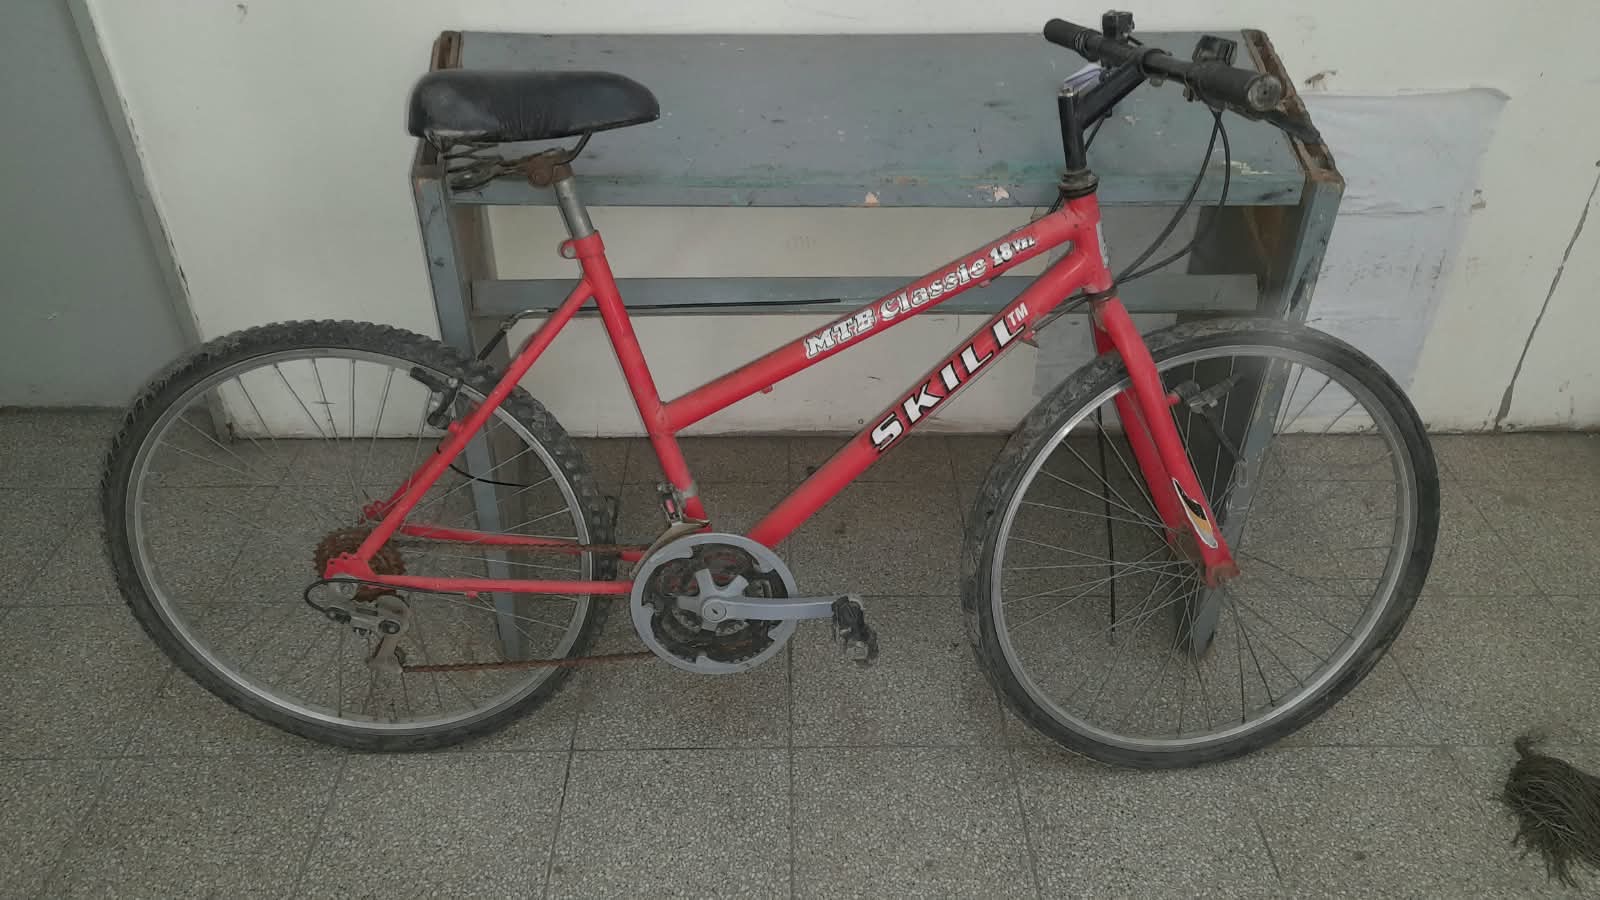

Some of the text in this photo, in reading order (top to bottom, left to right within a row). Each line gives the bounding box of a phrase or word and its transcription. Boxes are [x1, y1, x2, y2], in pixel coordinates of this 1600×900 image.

[803, 306, 876, 359] MTB
[989, 242, 1013, 268] 18
[870, 316, 1026, 453] SKILL
